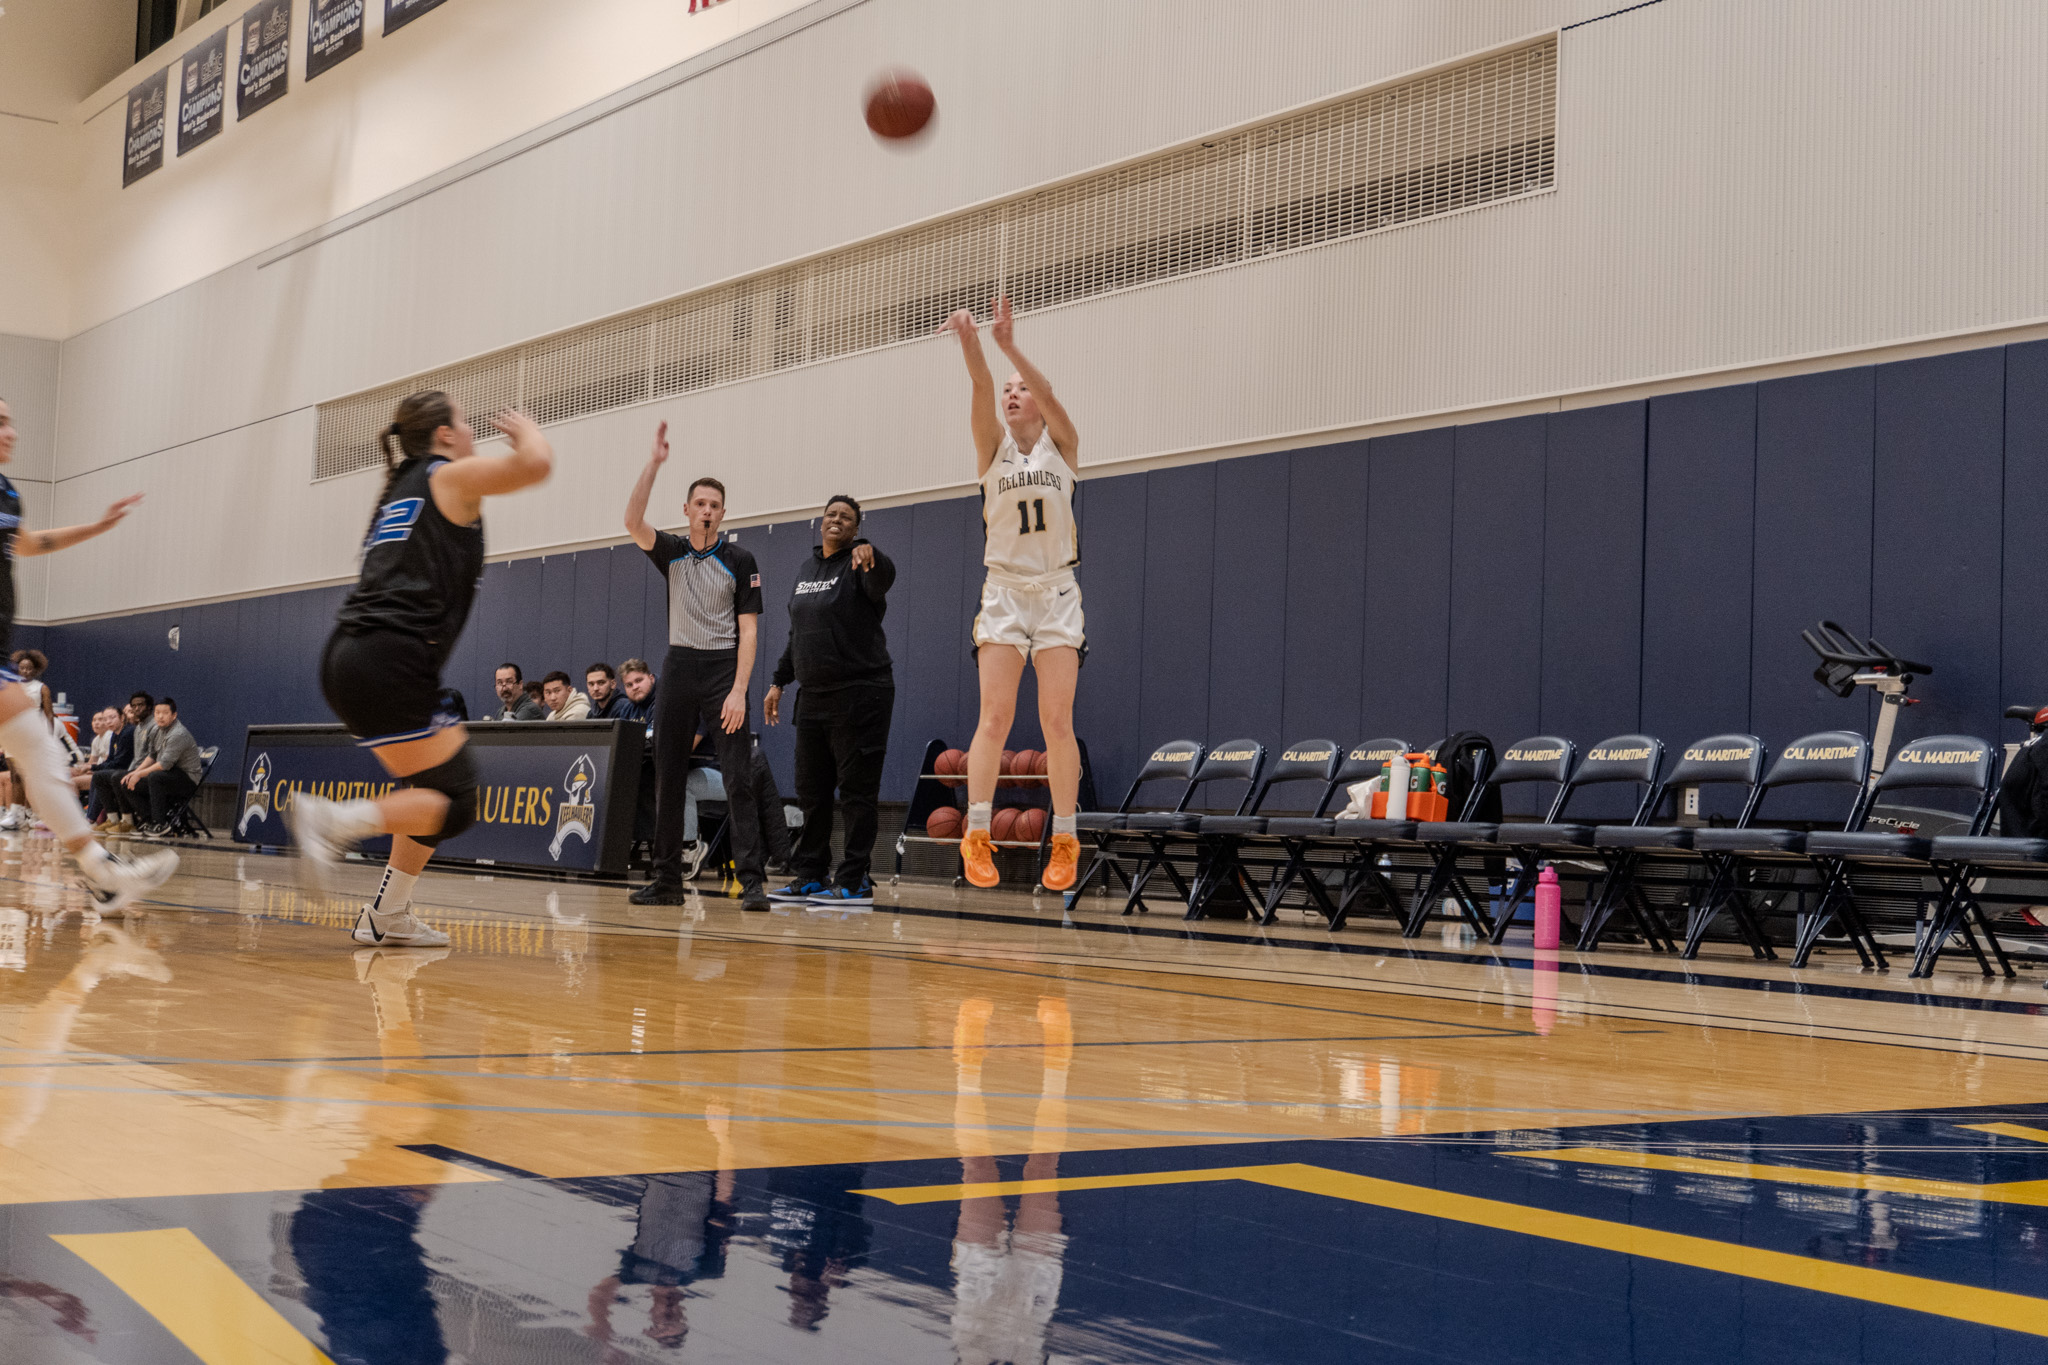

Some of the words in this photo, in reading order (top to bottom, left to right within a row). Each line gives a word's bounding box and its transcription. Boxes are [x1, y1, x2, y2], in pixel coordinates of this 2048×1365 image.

[312, 0, 363, 43] CHAMPIONS
[240, 40, 288, 85] CHAMPIONS
[182, 80, 223, 122] CHAMPIONS
[128, 118, 163, 156] CHAMPIONS
[1017, 498, 1047, 536] 11
[1151, 751, 1165, 762] CAL
[1165, 751, 1195, 762] MARITIME
[1209, 751, 1223, 761] CAL
[1224, 750, 1256, 761] MARITIME
[1282, 751, 1297, 761] CAL
[1297, 751, 1332, 762] MARITIME
[1350, 750, 1365, 761] CAL
[1504, 750, 1521, 761] CAL
[1521, 749, 1564, 762] MARITIME
[1588, 749, 1606, 760] CAL
[1607, 748, 1651, 760] MARITIME
[1684, 749, 1704, 760] CAL
[1705, 748, 1753, 761] MARITIME
[1783, 747, 1804, 760] CAL
[1806, 746, 1858, 760] MARITIME
[1898, 750, 1922, 763] CAL
[1923, 750, 1983, 764] MARITIME
